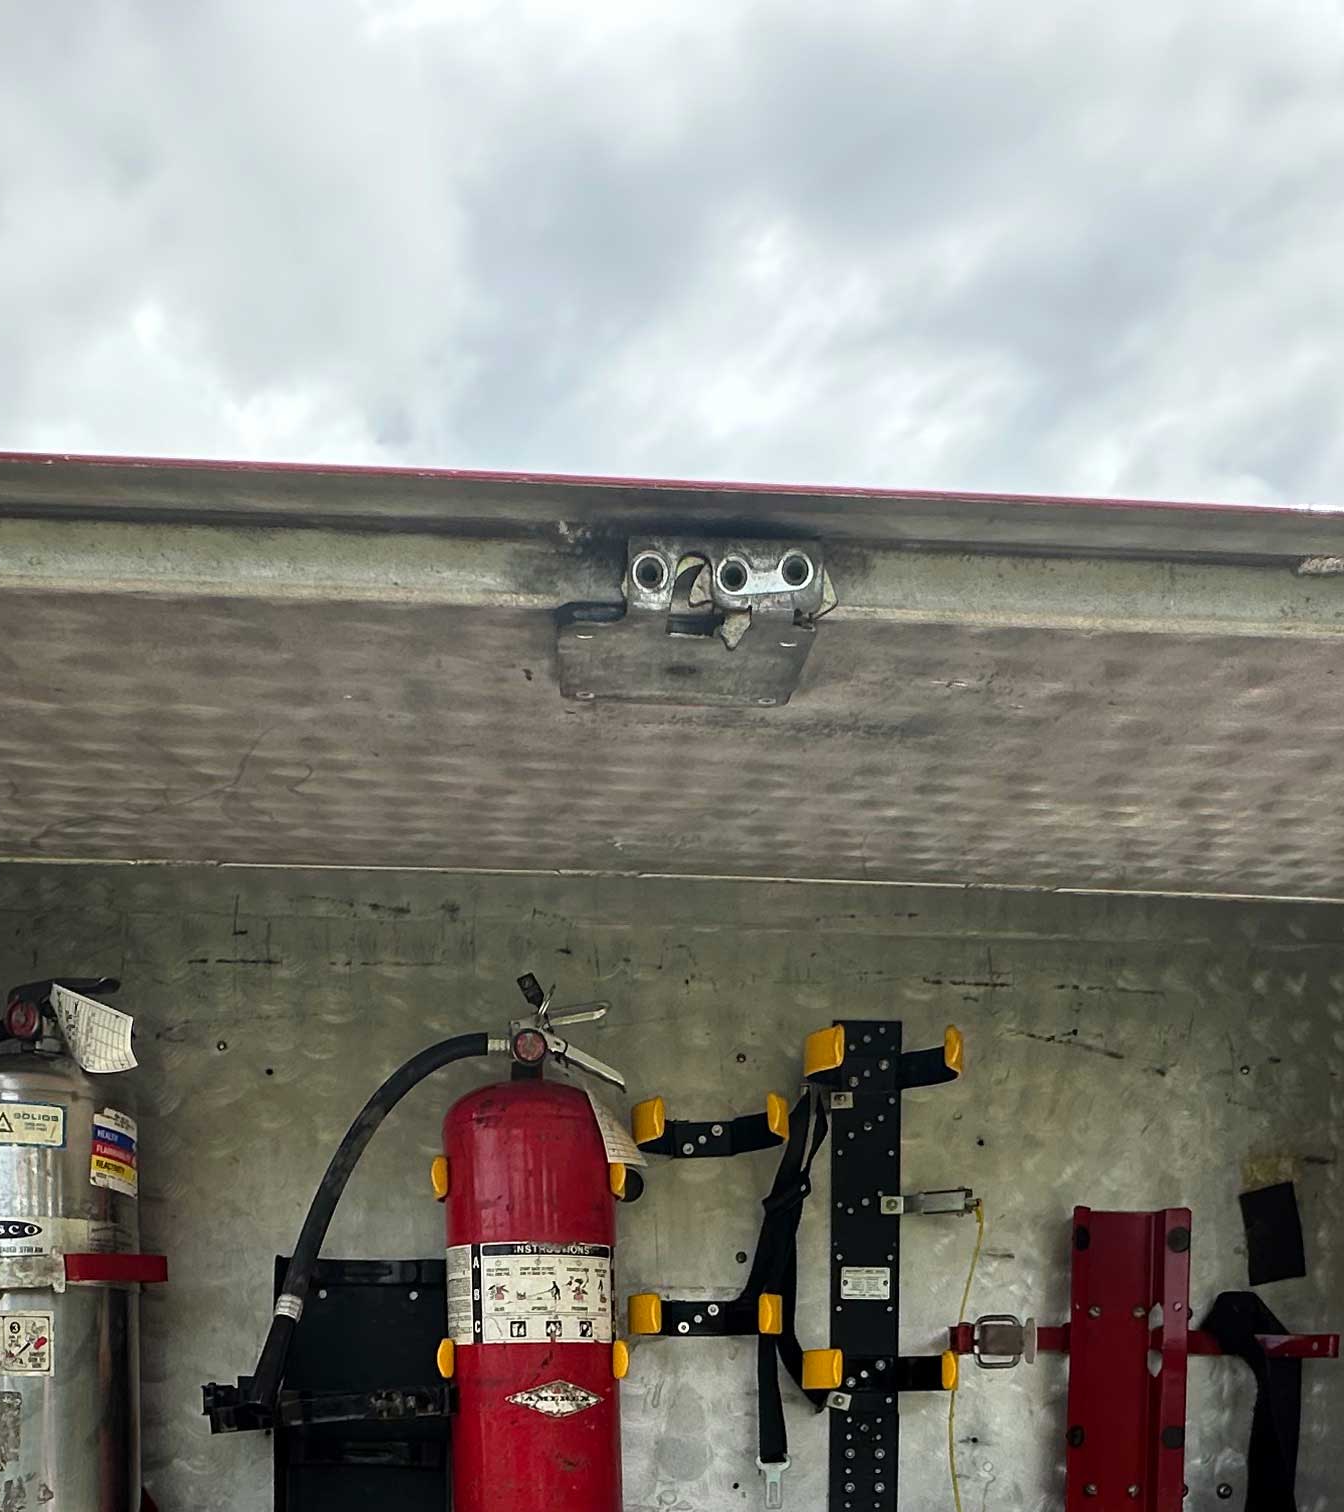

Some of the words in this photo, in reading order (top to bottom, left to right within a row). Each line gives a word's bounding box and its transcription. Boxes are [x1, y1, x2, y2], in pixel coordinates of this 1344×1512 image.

[514, 1244, 590, 1254] INSTRUIONS
[472, 1256, 480, 1269] A
[473, 1288, 481, 1301] B
[474, 1320, 481, 1333] C
